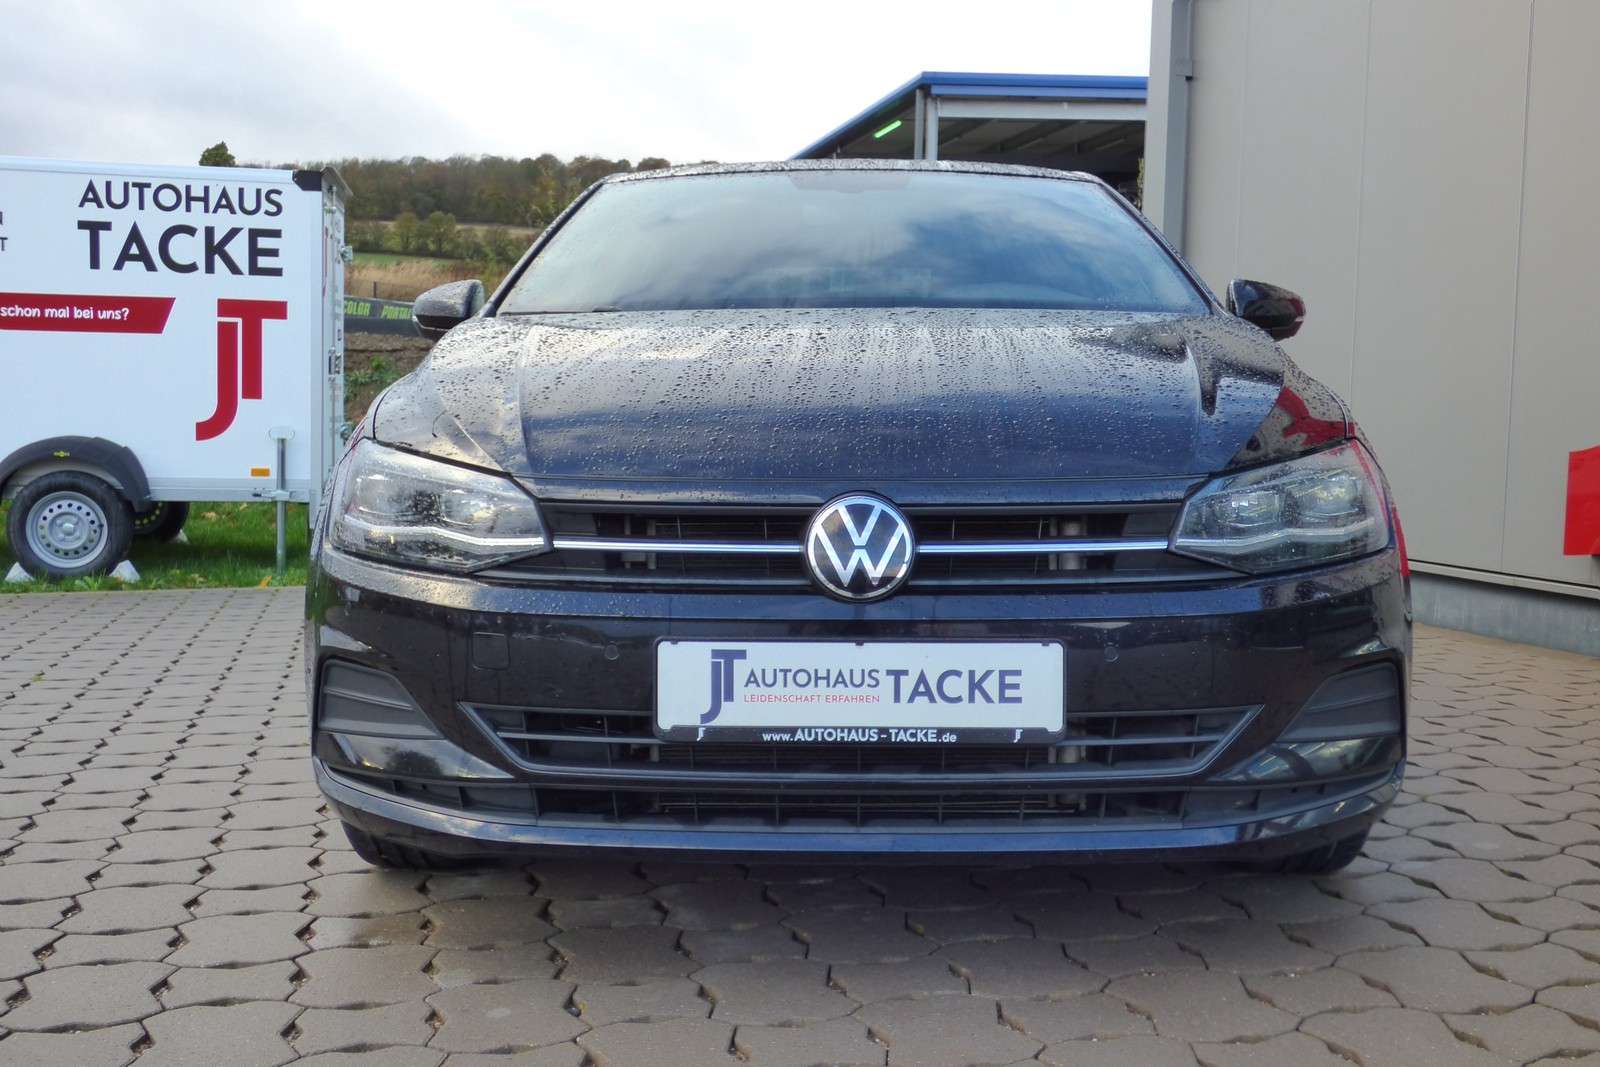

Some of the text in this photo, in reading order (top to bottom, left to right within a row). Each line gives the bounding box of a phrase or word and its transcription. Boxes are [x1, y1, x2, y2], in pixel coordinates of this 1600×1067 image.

[78, 179, 283, 217] AUTOHAUS
[77, 220, 284, 277] TACKE
[0, 304, 130, 321] schon mal bei uns?
[195, 298, 288, 441] JT
[700, 649, 748, 725] JT
[743, 668, 1023, 705] AUTOHAUS TACKE
[743, 694, 881, 704] LEIDENSCHAFT ERFAHREN
